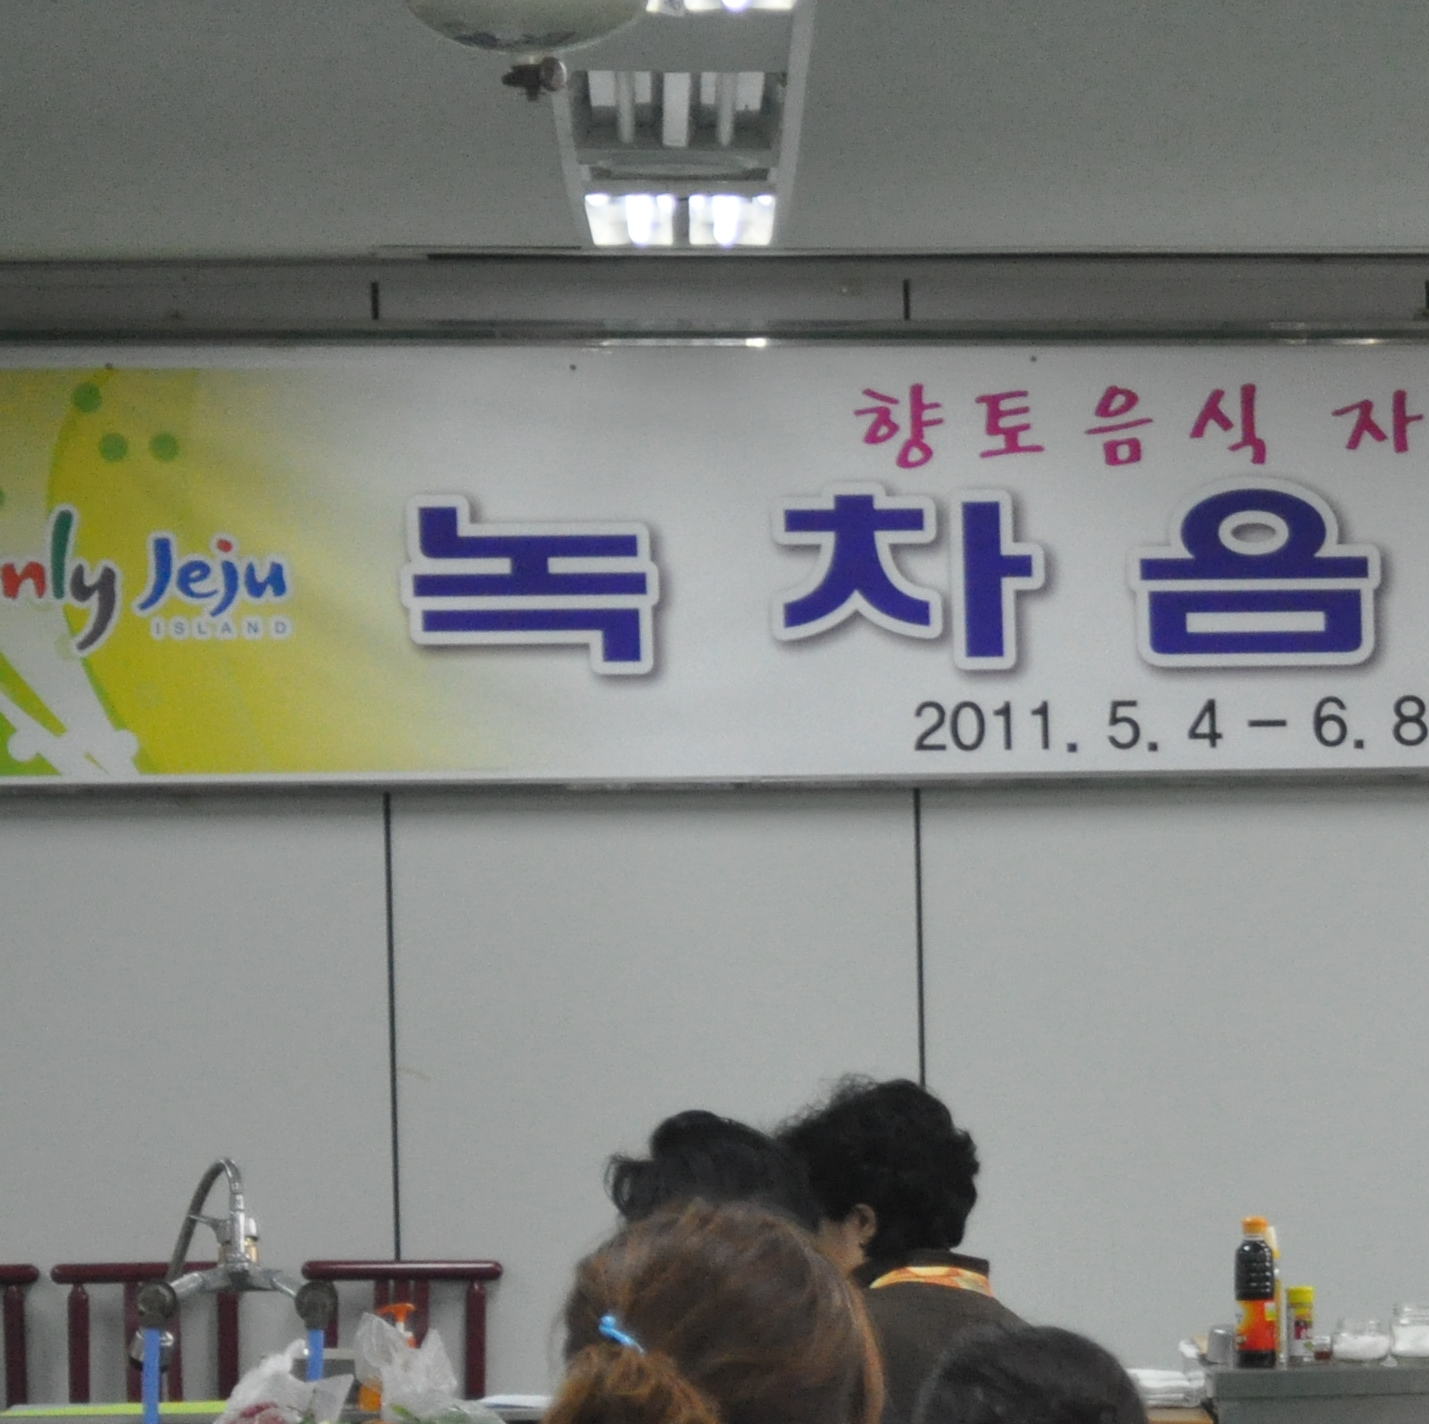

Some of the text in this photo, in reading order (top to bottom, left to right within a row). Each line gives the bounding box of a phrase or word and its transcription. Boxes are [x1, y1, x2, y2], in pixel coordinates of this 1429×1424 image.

[856, 383, 1268, 469] 향토음식
[138, 537, 287, 617] Jeju
[154, 620, 288, 634] ISLAND
